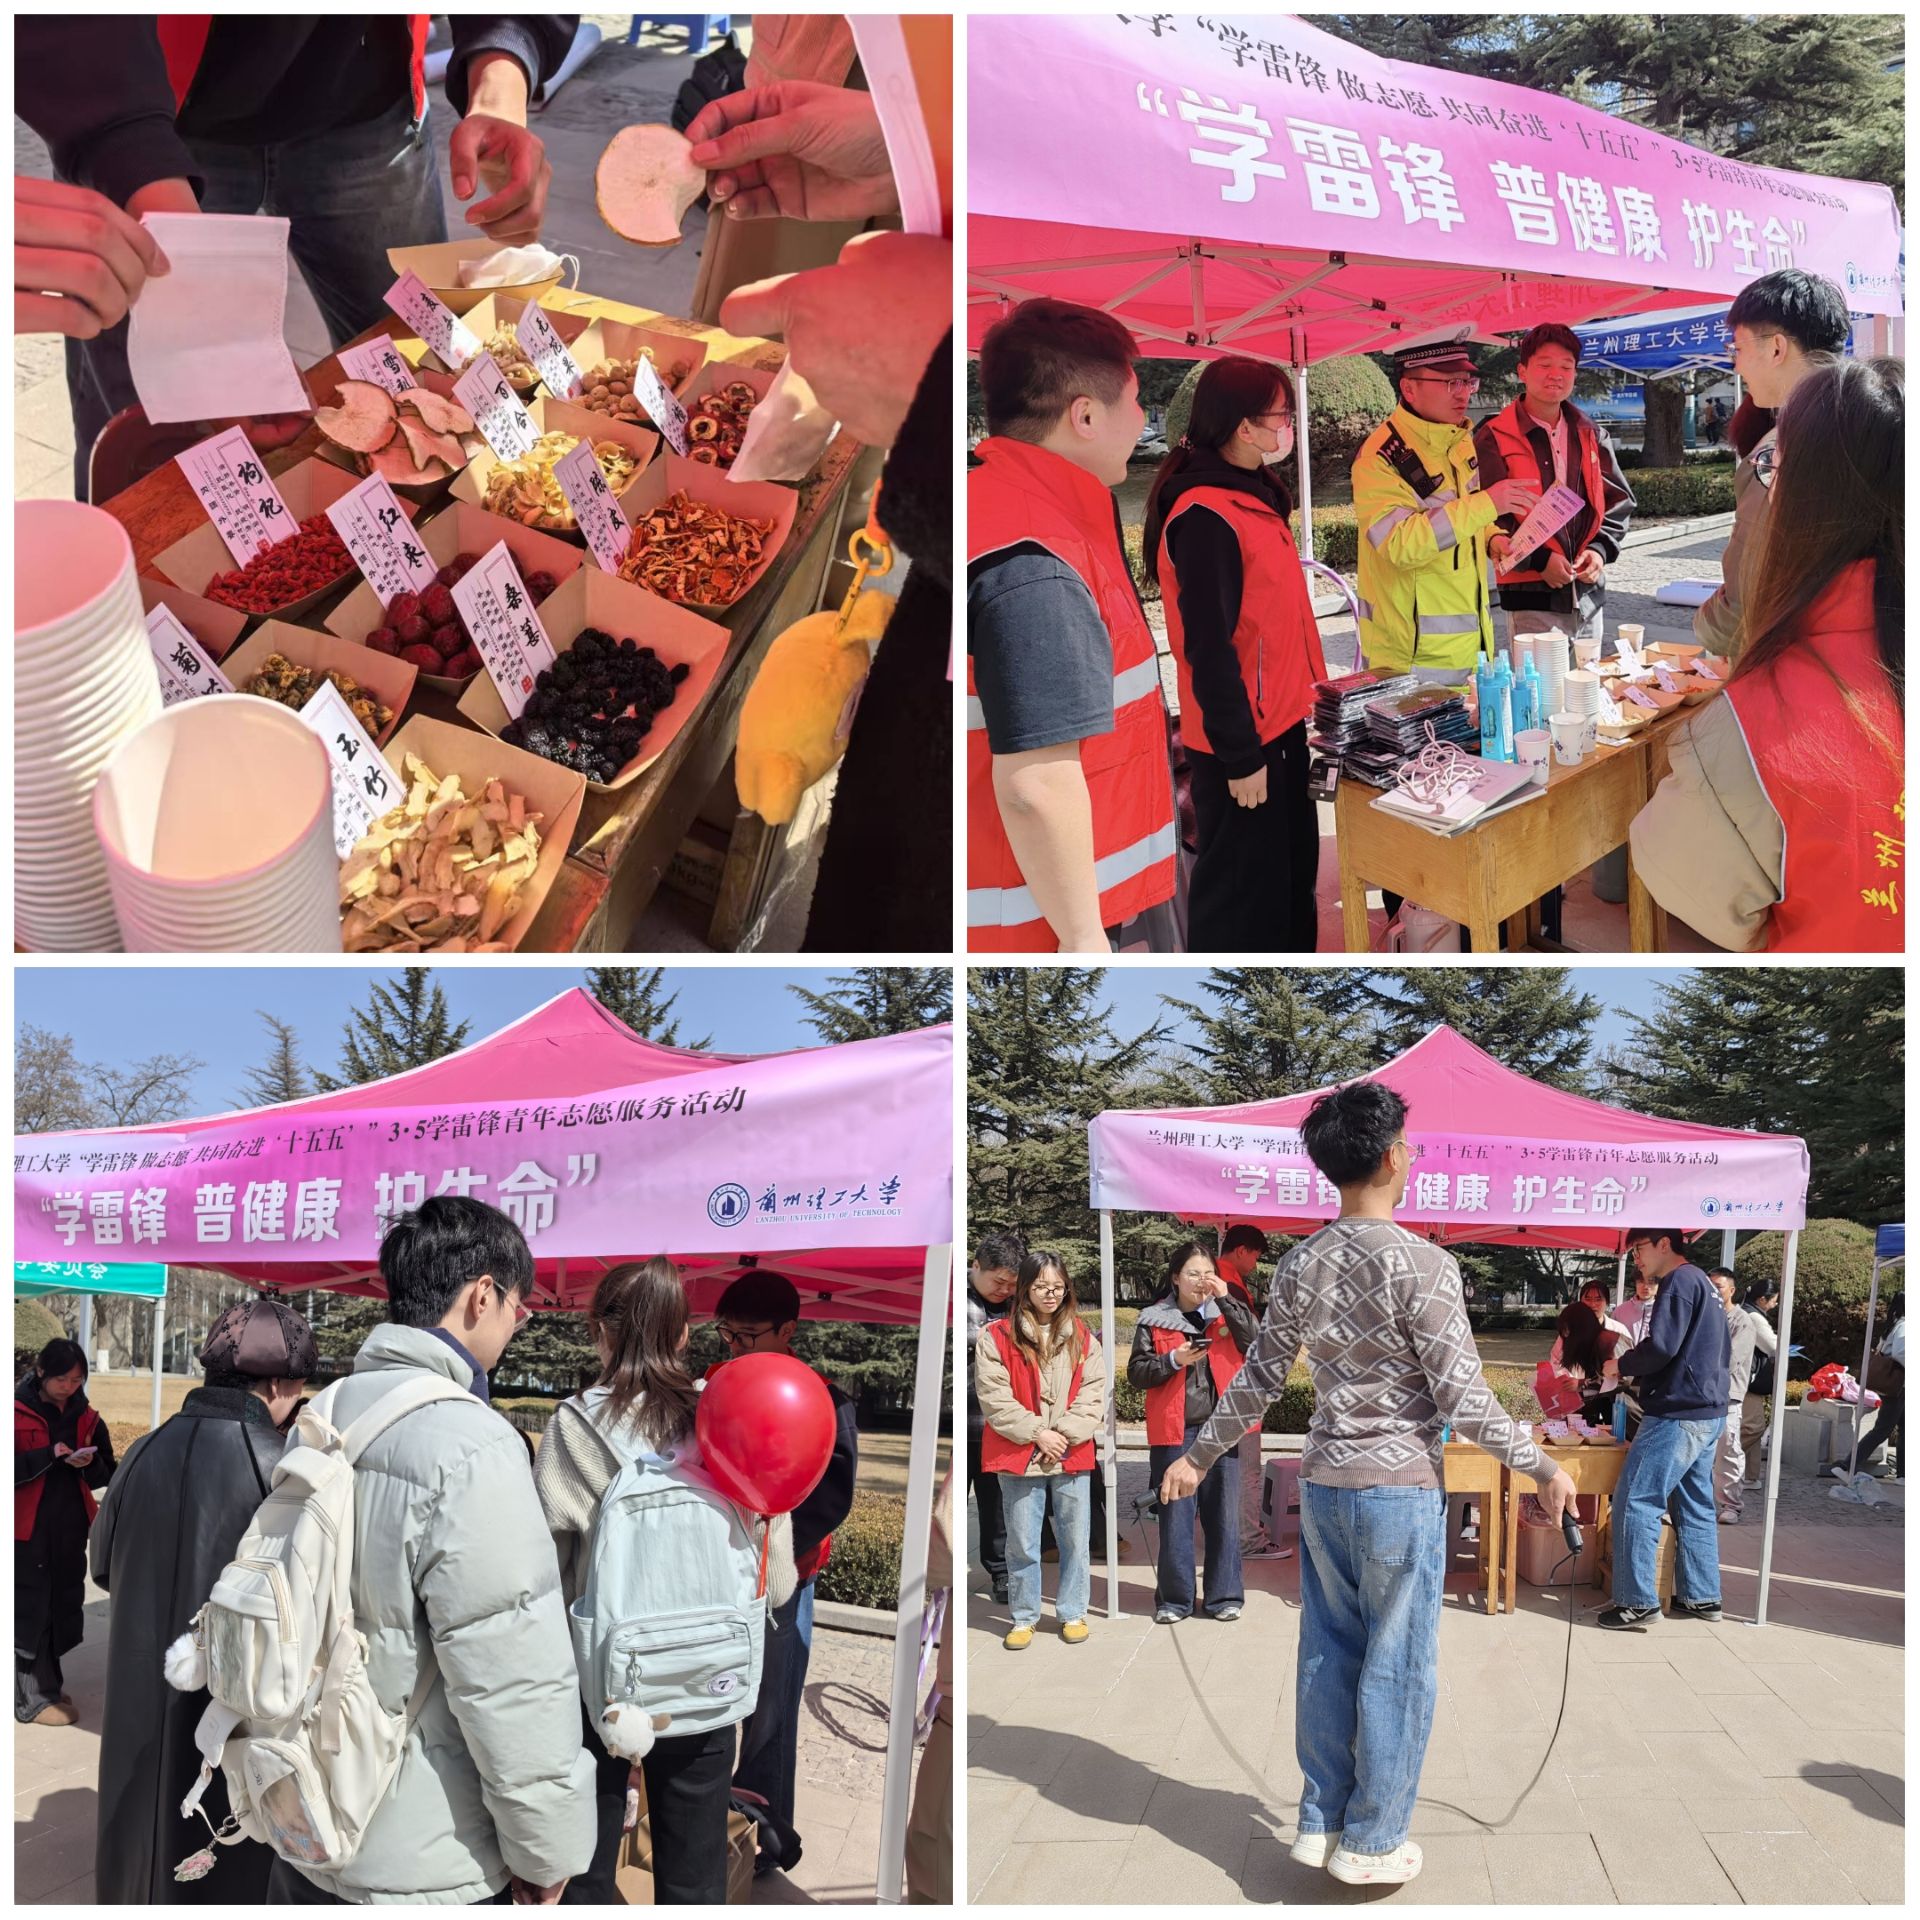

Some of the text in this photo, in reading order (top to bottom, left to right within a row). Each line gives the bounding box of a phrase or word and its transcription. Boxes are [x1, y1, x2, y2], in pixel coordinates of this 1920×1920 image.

[1337, 67, 1440, 119] 做志愿
[1441, 97, 1553, 142] 共同奋进
[1136, 82, 1806, 275] “学雷锋 普健康 护生命”
[1583, 319, 1733, 357] 兰州理工大学学
[495, 380, 528, 430] 百合
[378, 508, 425, 569] 红枣
[504, 583, 540, 648] 桑葚
[336, 733, 388, 801] 玉竹
[139, 1148, 188, 1171] 做志愿
[190, 1136, 266, 1166] 共同奋进
[388, 1086, 747, 1142] 3·5学雷锋青年志愿服务活动
[1146, 1130, 1245, 1150] 兰州理工大学
[1521, 1146, 1719, 1165] 3·5学雷锋青年志愿服务活动
[41, 1186, 168, 1247] “学雷锋
[193, 1177, 342, 1244] 普健康
[756, 1215, 788, 1224] LANZHOU
[790, 1213, 836, 1222] UNIVERSITY
[853, 1208, 902, 1218] TECHNOLOGY
[1404, 1171, 1490, 1213] 健康
[1512, 1175, 1648, 1216] 护生命”
